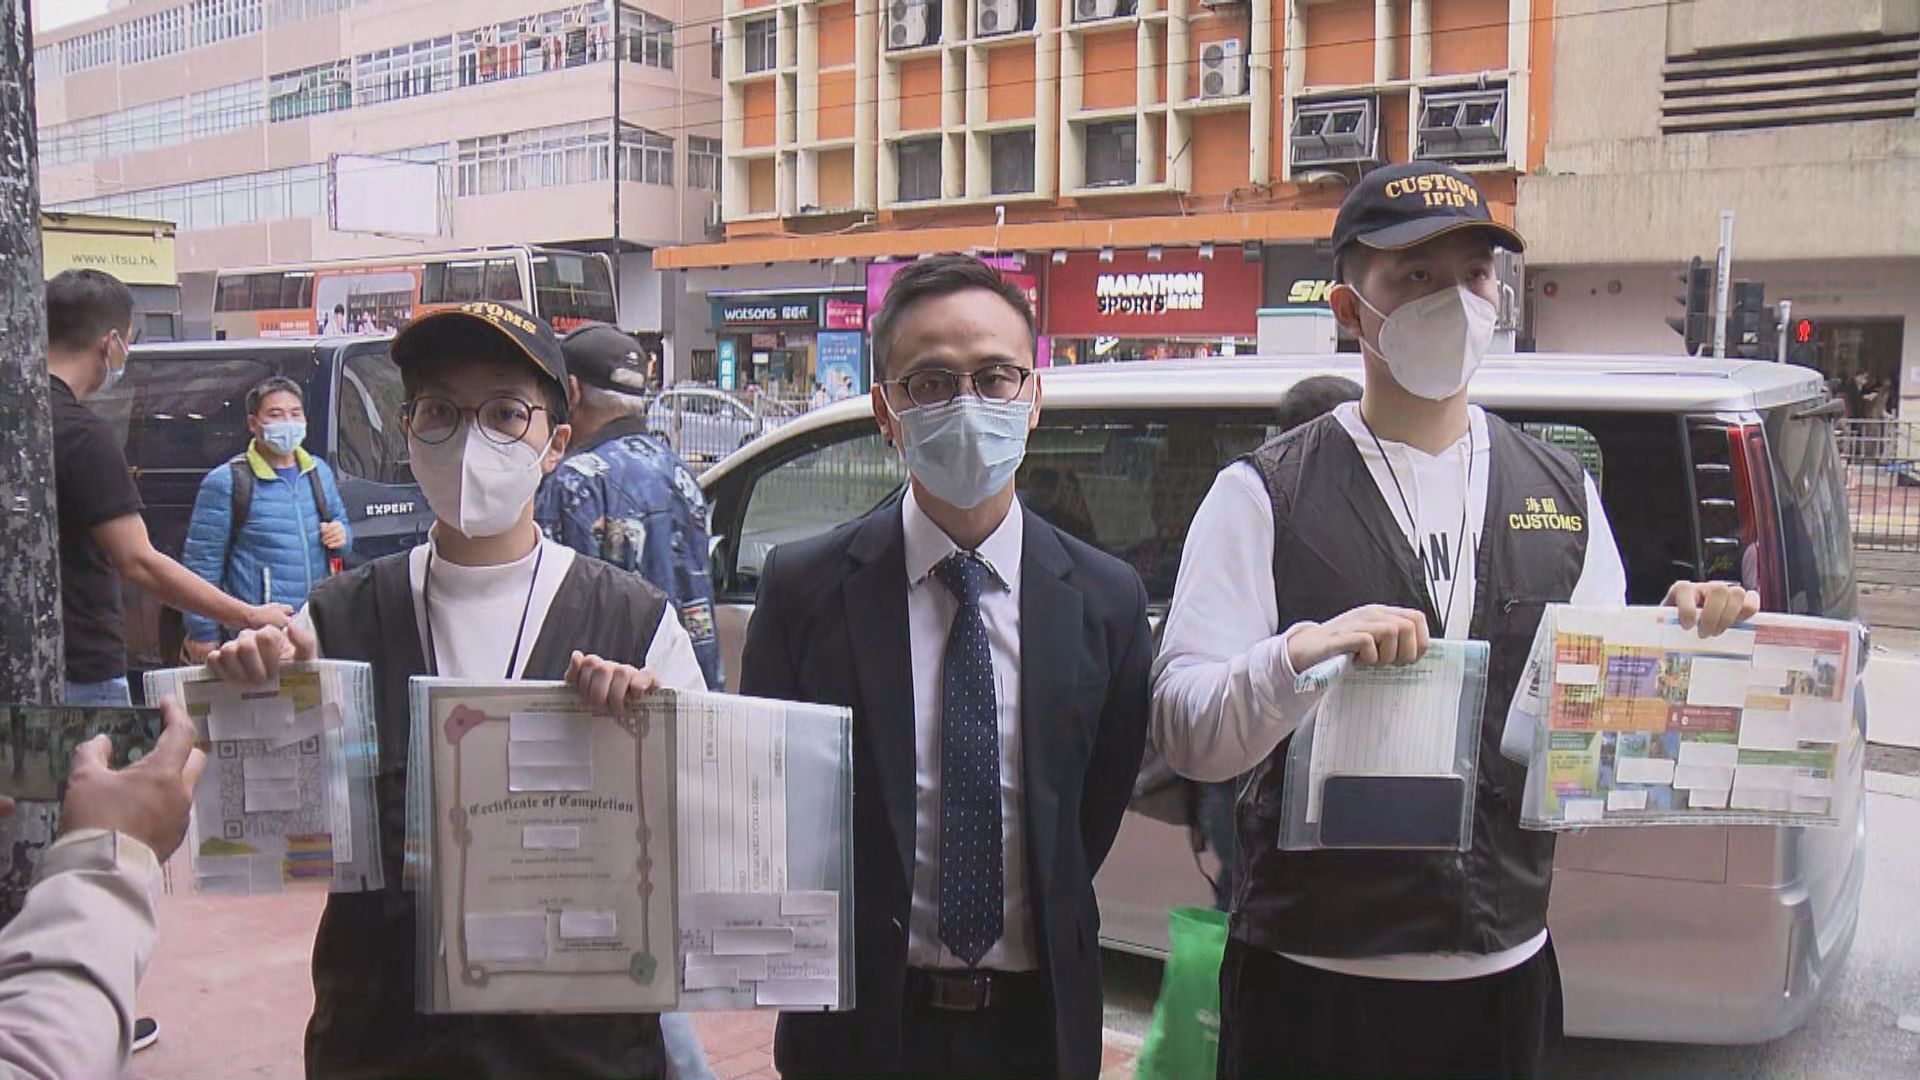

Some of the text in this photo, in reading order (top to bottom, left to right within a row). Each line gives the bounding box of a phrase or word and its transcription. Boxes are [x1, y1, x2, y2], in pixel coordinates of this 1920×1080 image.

[71, 252, 157, 266] www.itsu.hk
[1096, 272, 1204, 297] MARATHON
[724, 308, 777, 320] watsons
[1097, 296, 1167, 315] SPORTS
[366, 502, 415, 516] EXPERT
[1509, 512, 1583, 532] CUSTOMS
[469, 794, 634, 816] Certificate of Completion
